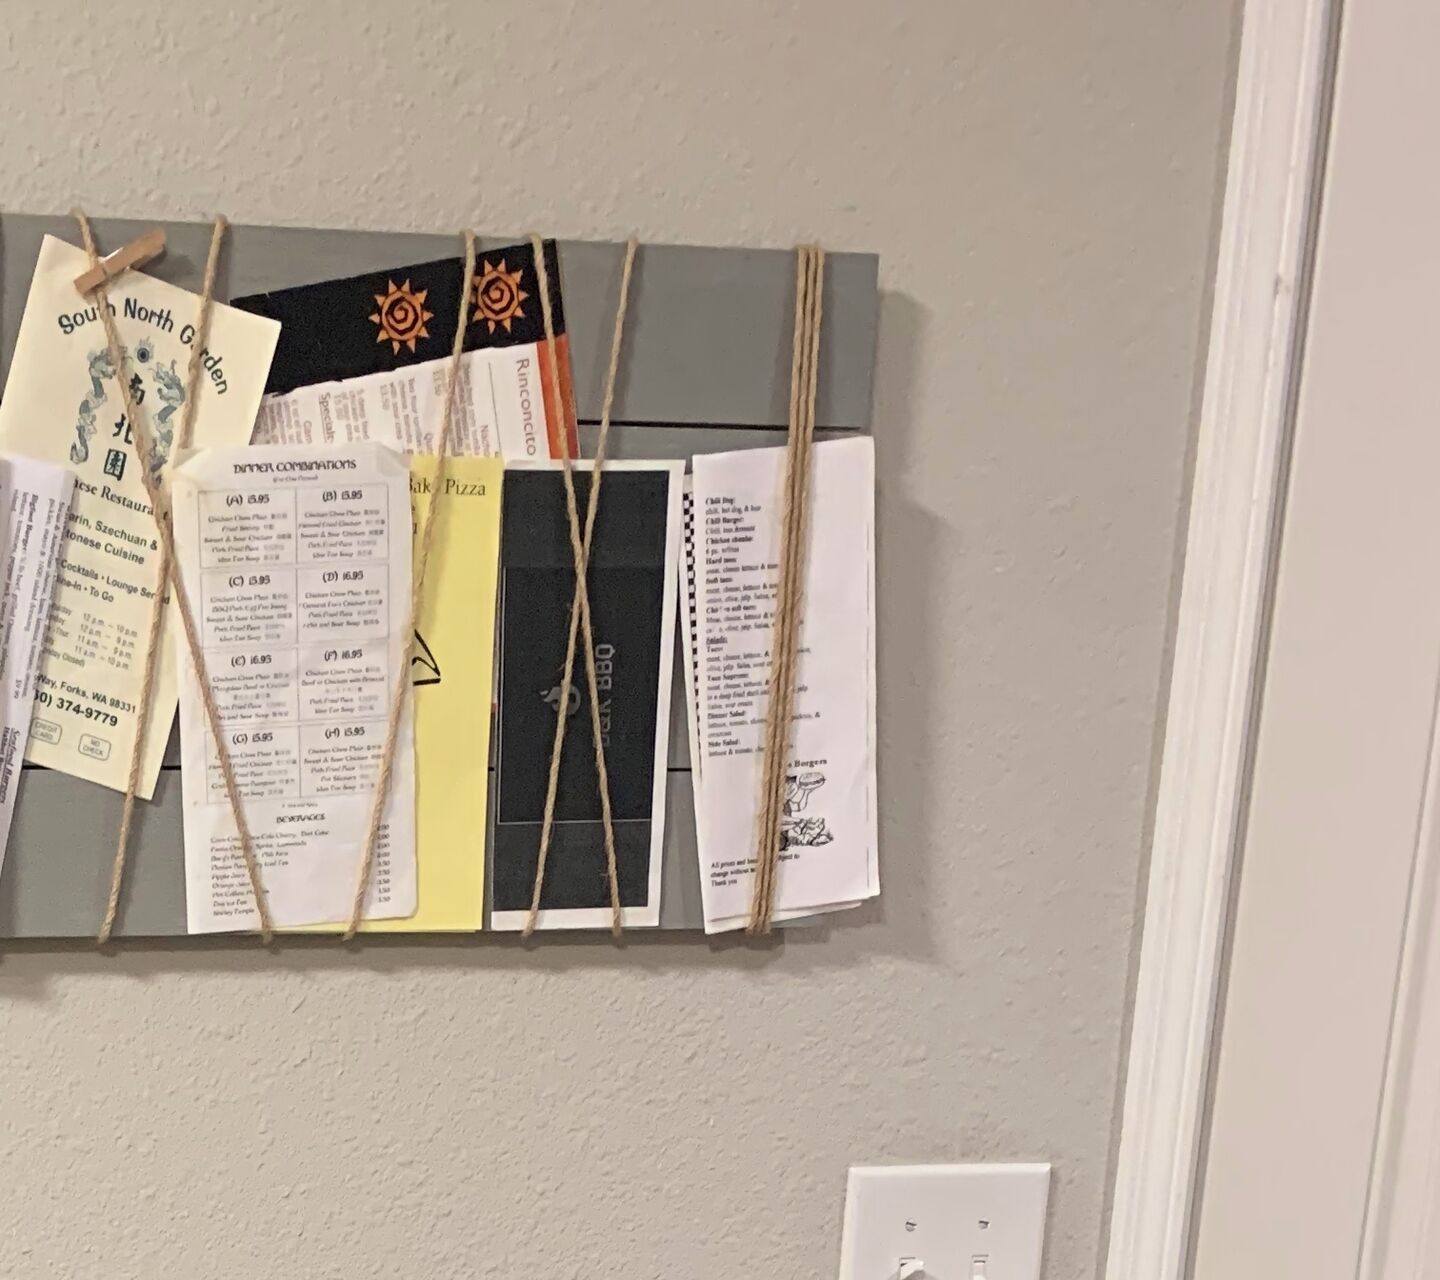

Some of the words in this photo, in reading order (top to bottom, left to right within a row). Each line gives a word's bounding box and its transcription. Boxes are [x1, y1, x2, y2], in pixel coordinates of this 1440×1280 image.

[58, 303, 116, 335] Souh
[124, 297, 174, 333] North
[179, 325, 229, 395] Grden
[515, 357, 537, 456] Rinconcito
[233, 461, 274, 475] DINNER
[276, 458, 357, 472] COMBINATIONS
[101, 484, 168, 521] Restaurat
[445, 478, 486, 496] Pizza
[95, 519, 147, 548] Szechuan
[149, 539, 159, 552] &
[104, 542, 145, 565] Cuisine
[89, 585, 100, 597] To
[101, 590, 114, 603] Go
[106, 575, 140, 595] Lounge
[594, 643, 616, 691] BBQ
[57, 696, 118, 727] 374-9779
[60, 680, 88, 700] Forks,
[92, 691, 107, 706] WA
[109, 696, 136, 714] 98331
[82, 745, 104, 758] CHECK
